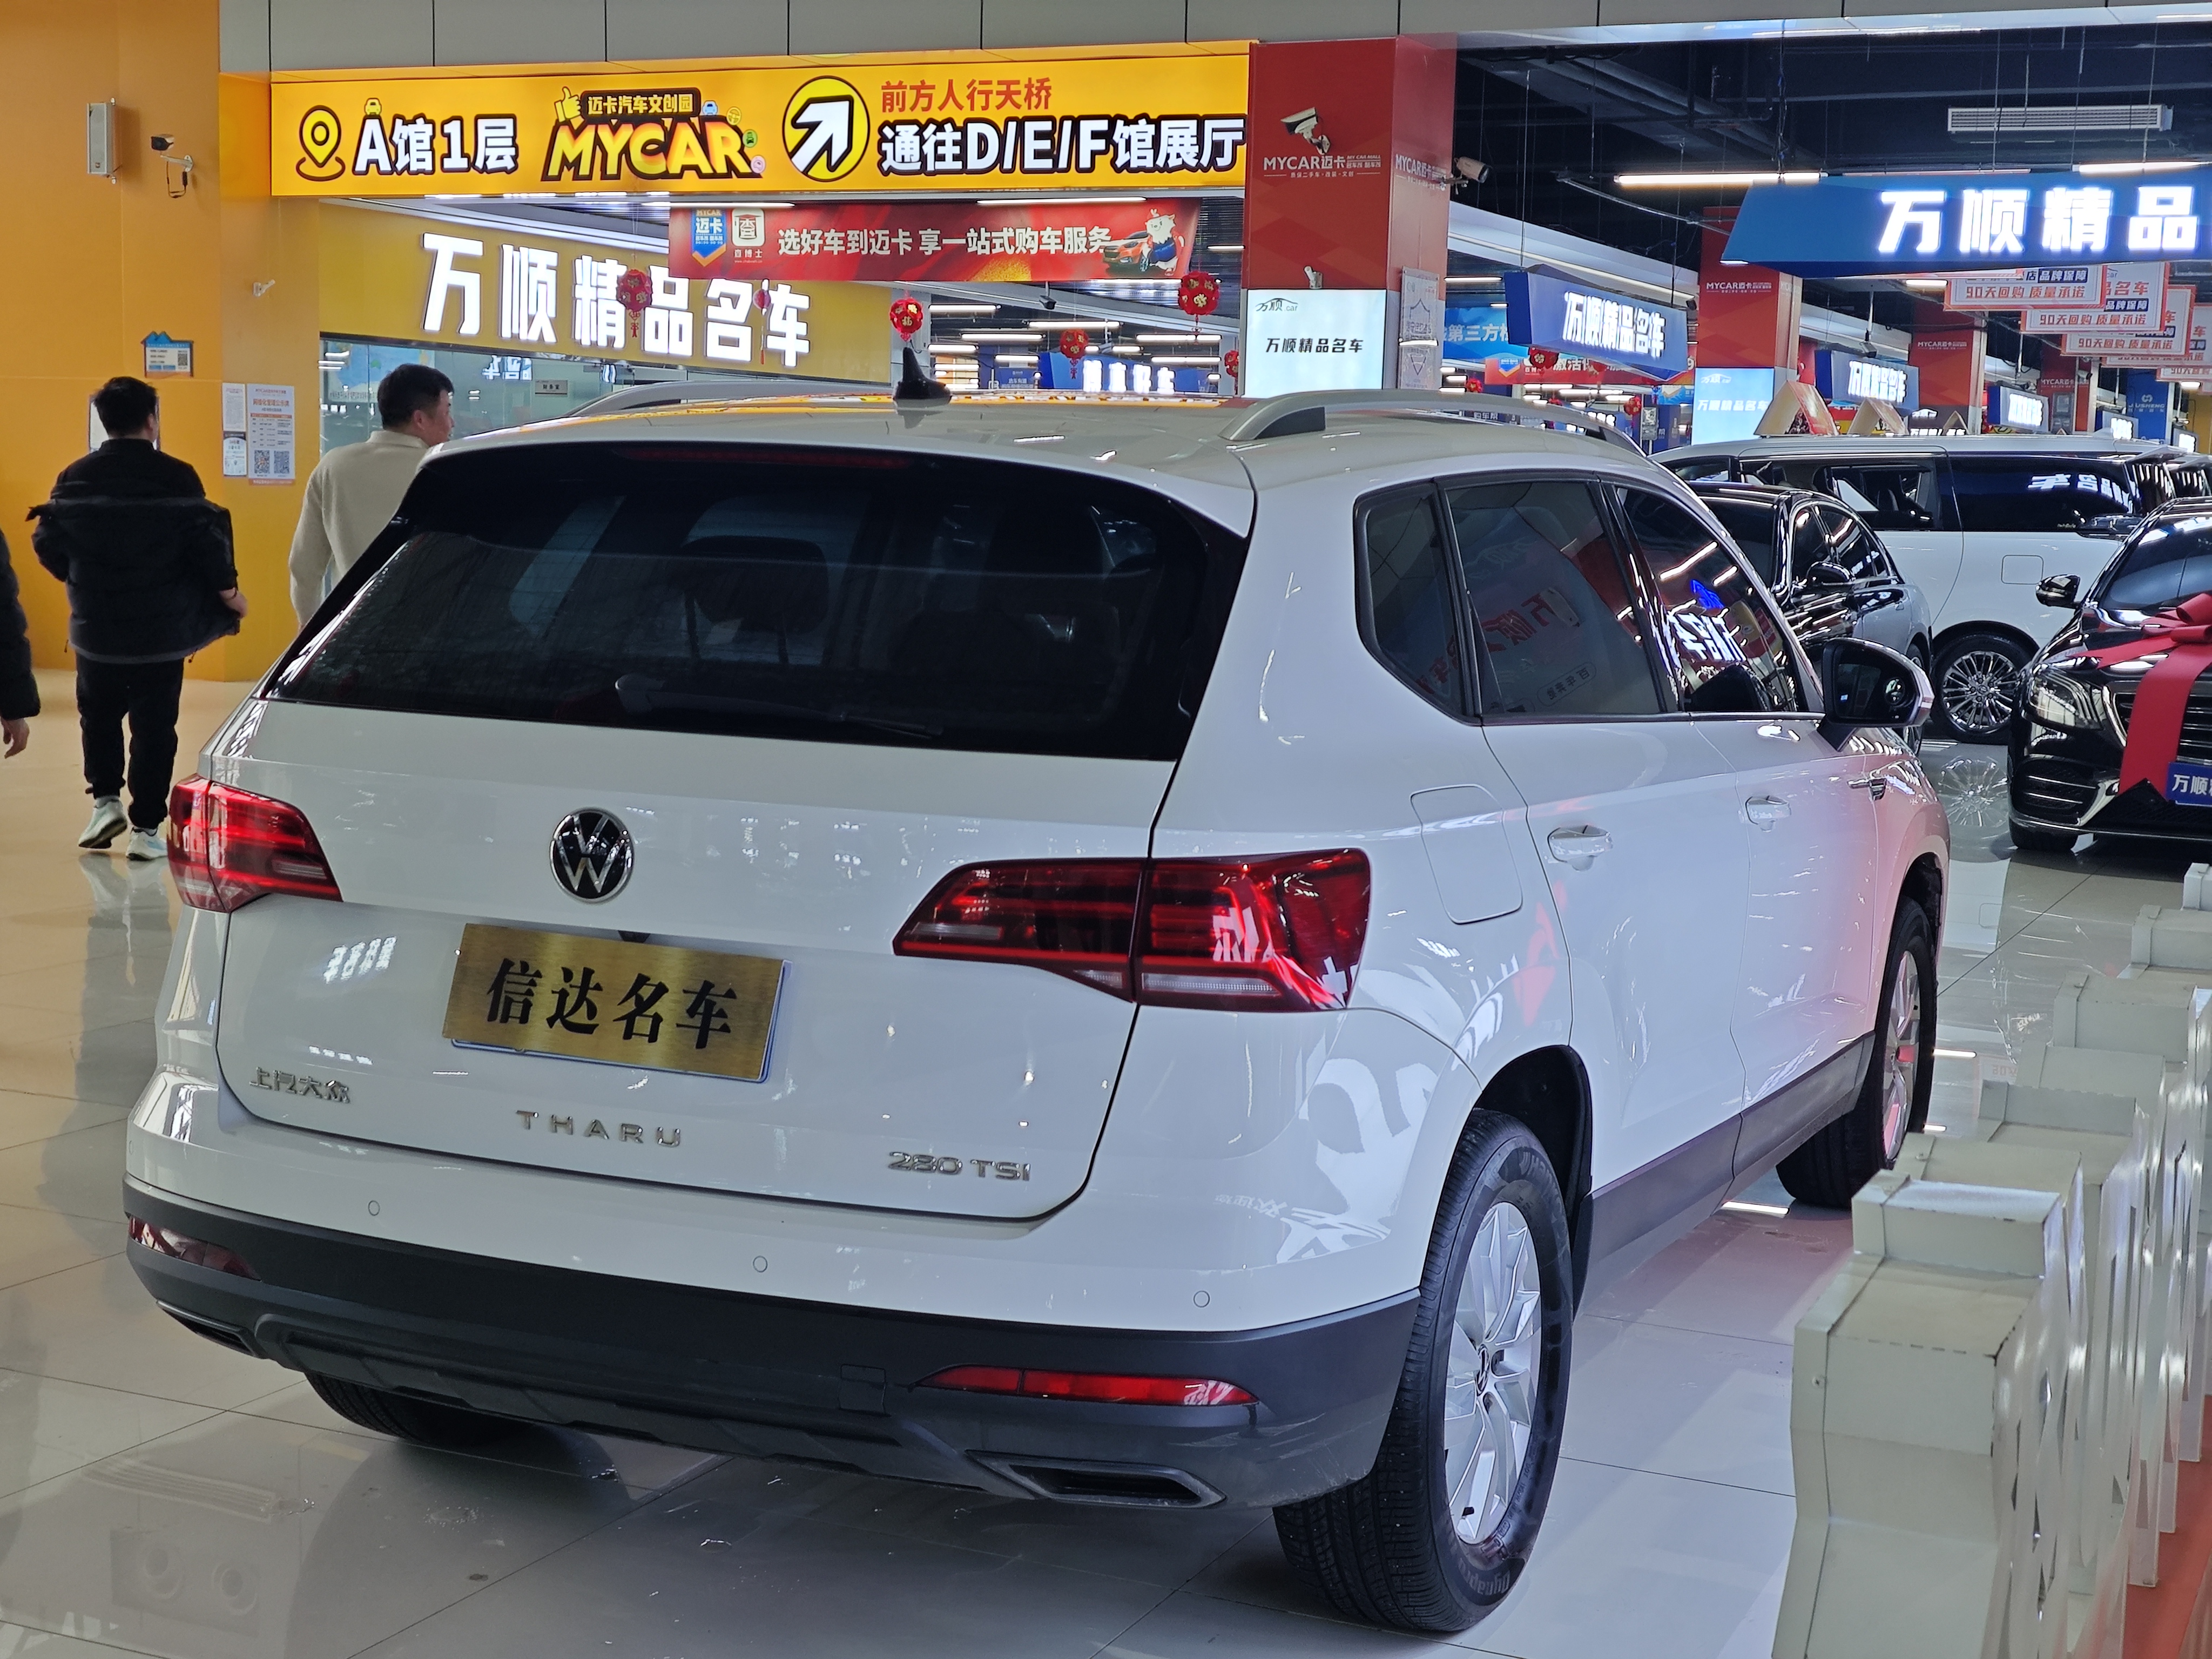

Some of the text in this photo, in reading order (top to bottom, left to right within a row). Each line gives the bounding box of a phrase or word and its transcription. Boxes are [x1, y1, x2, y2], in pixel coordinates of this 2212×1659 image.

[588, 93, 693, 115] 迈卡汽车文创园
[881, 77, 1052, 112] 前方人行天桥
[353, 113, 517, 174] A馆1层
[544, 119, 757, 179] MYCAR
[881, 117, 1245, 173] 通往D/E/F馆展厅
[1263, 156, 1345, 171] MYCAR迈卡
[696, 217, 723, 234] 迈卡
[1878, 186, 2200, 253] 万顺精品
[778, 225, 1111, 256] 选好车到迈卡 享一站式购车服务
[1966, 286, 2086, 298] 90天回购 质量承诺
[2039, 269, 2087, 282] 品牌保障
[422, 231, 812, 368] 万顺精品名车
[1563, 292, 1667, 358] 万顺精品名车
[2040, 314, 2092, 325] 90天回购
[1266, 338, 1364, 353] 万顺精品名车
[2171, 774, 2212, 796] 万顺
[486, 957, 739, 1050] 信达名车
[249, 1066, 352, 1104] 上汽大众
[516, 1109, 682, 1148] THARU
[888, 1151, 1031, 1182] 280 TSI
